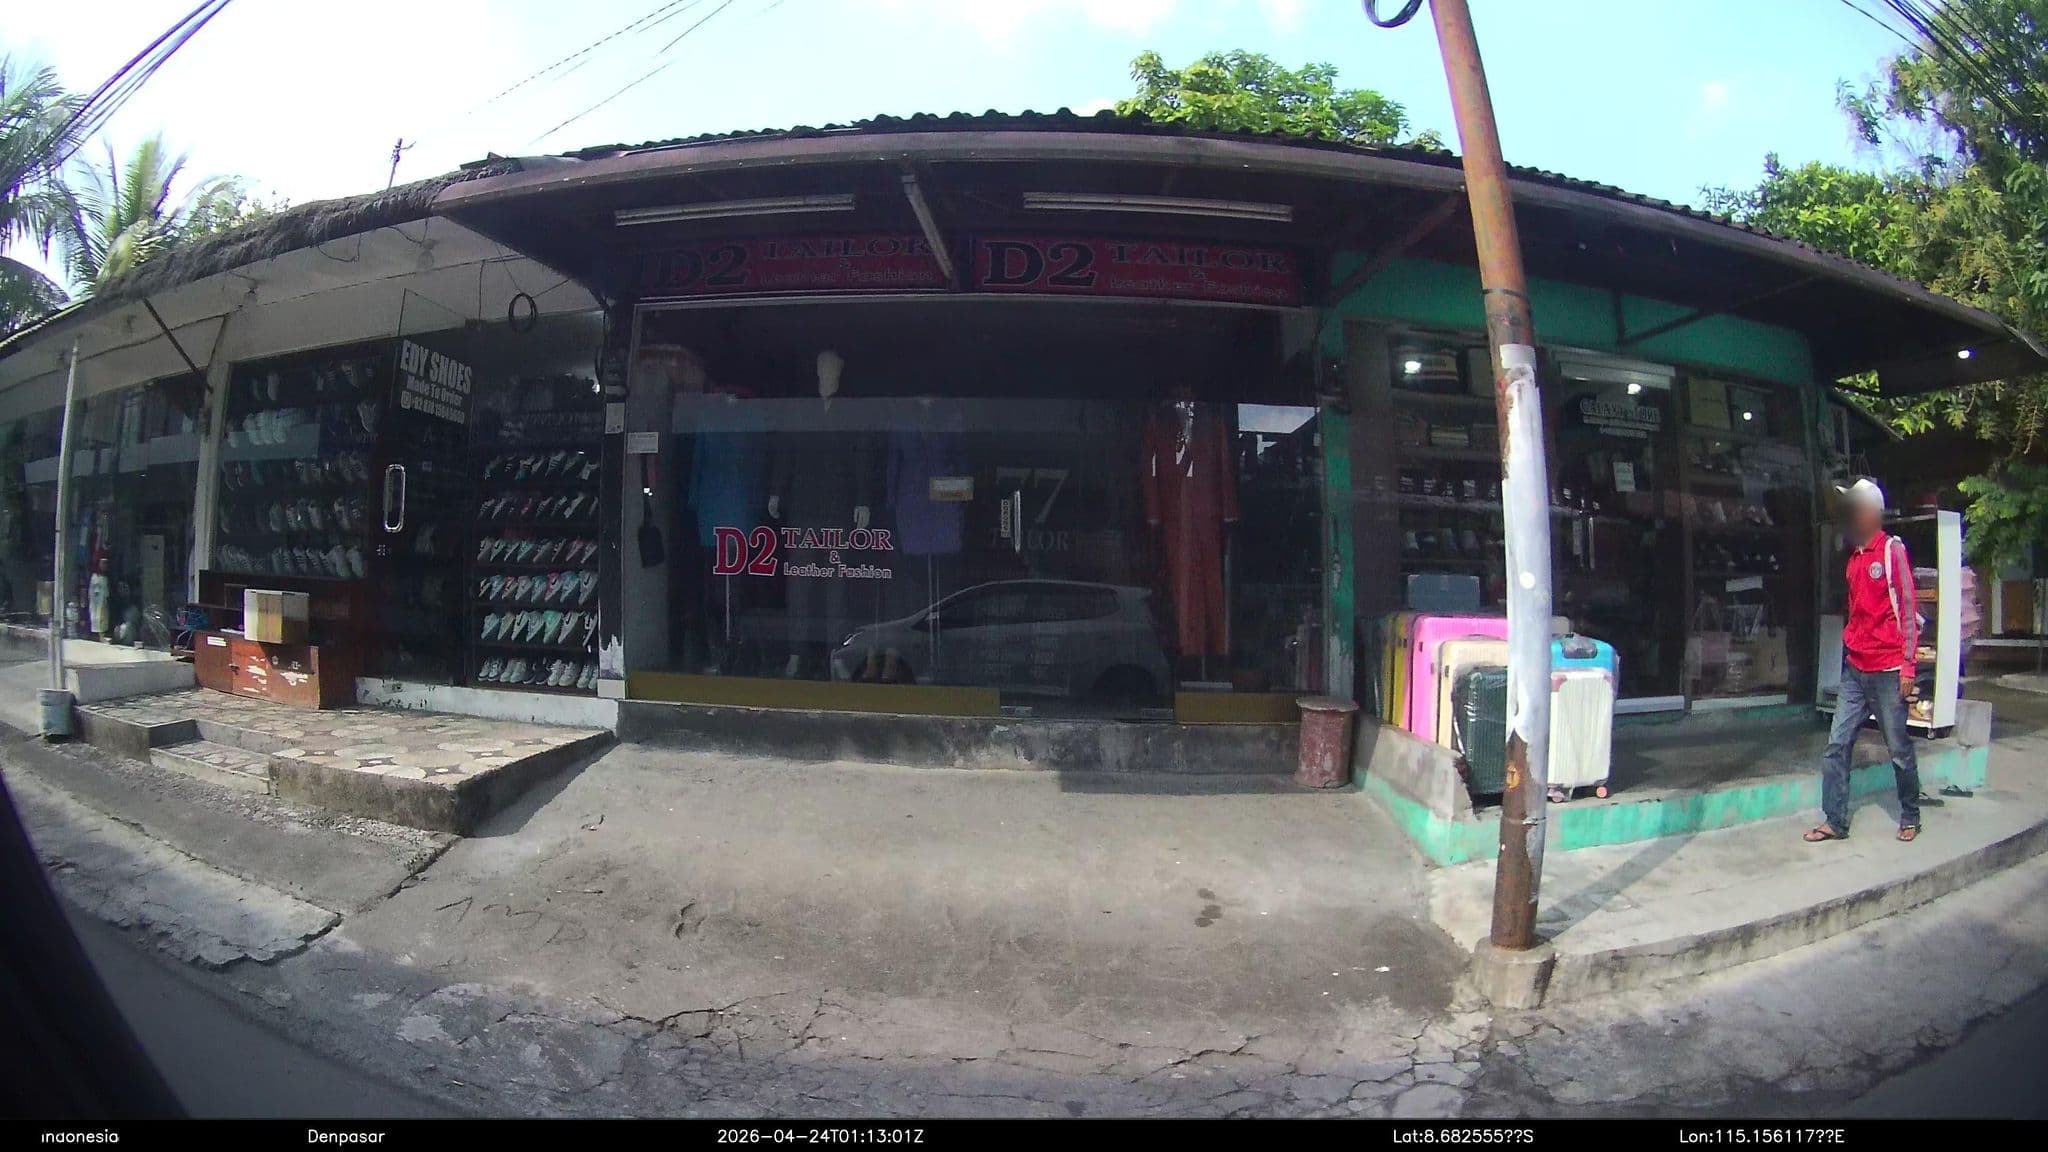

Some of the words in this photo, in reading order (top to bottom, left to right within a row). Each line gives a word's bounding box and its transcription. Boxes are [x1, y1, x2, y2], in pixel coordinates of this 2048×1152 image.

[761, 239, 933, 258] TAILOR
[1104, 243, 1288, 272] TAILOR
[982, 240, 1099, 287] D2
[400, 339, 429, 377] EDY
[430, 351, 472, 394] SHOES
[712, 525, 777, 576] D2
[781, 528, 893, 551] TAILOR
[829, 550, 840, 564] &
[783, 562, 834, 578] Leather
[838, 565, 892, 579] Fashion
